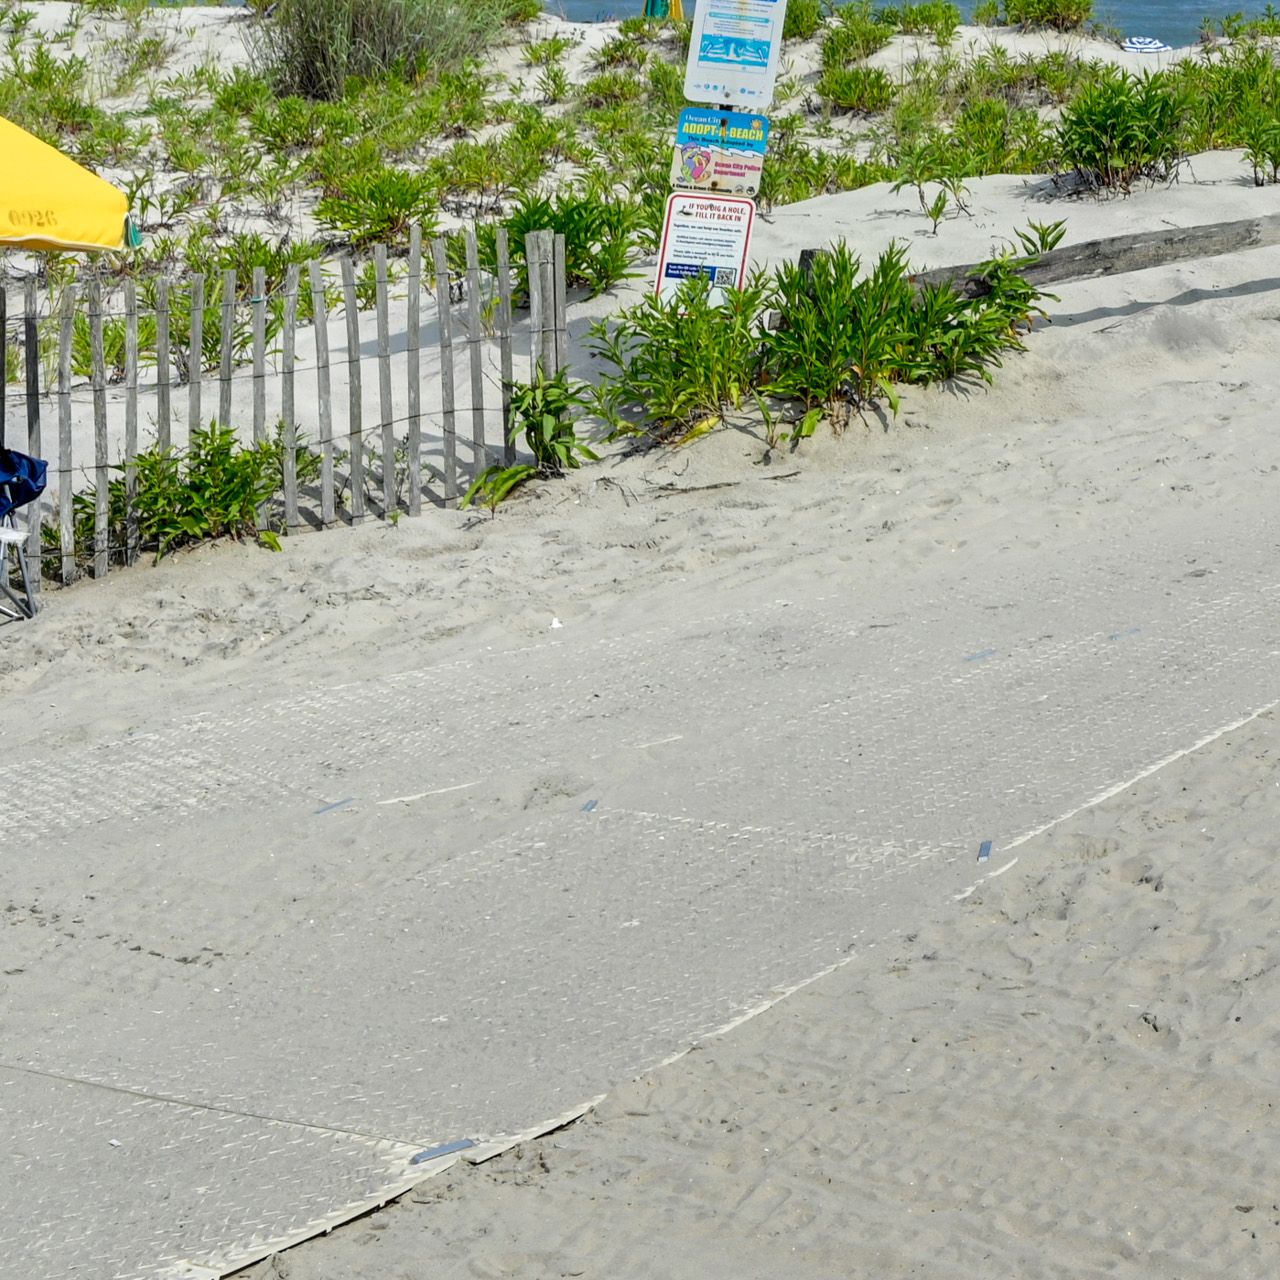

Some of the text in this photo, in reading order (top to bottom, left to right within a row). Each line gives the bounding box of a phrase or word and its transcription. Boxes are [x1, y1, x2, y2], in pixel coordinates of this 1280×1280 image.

[683, 123, 763, 140] ADOPT-A-BEACH
[710, 204, 721, 212] DIG
[695, 211, 708, 219] FILL
